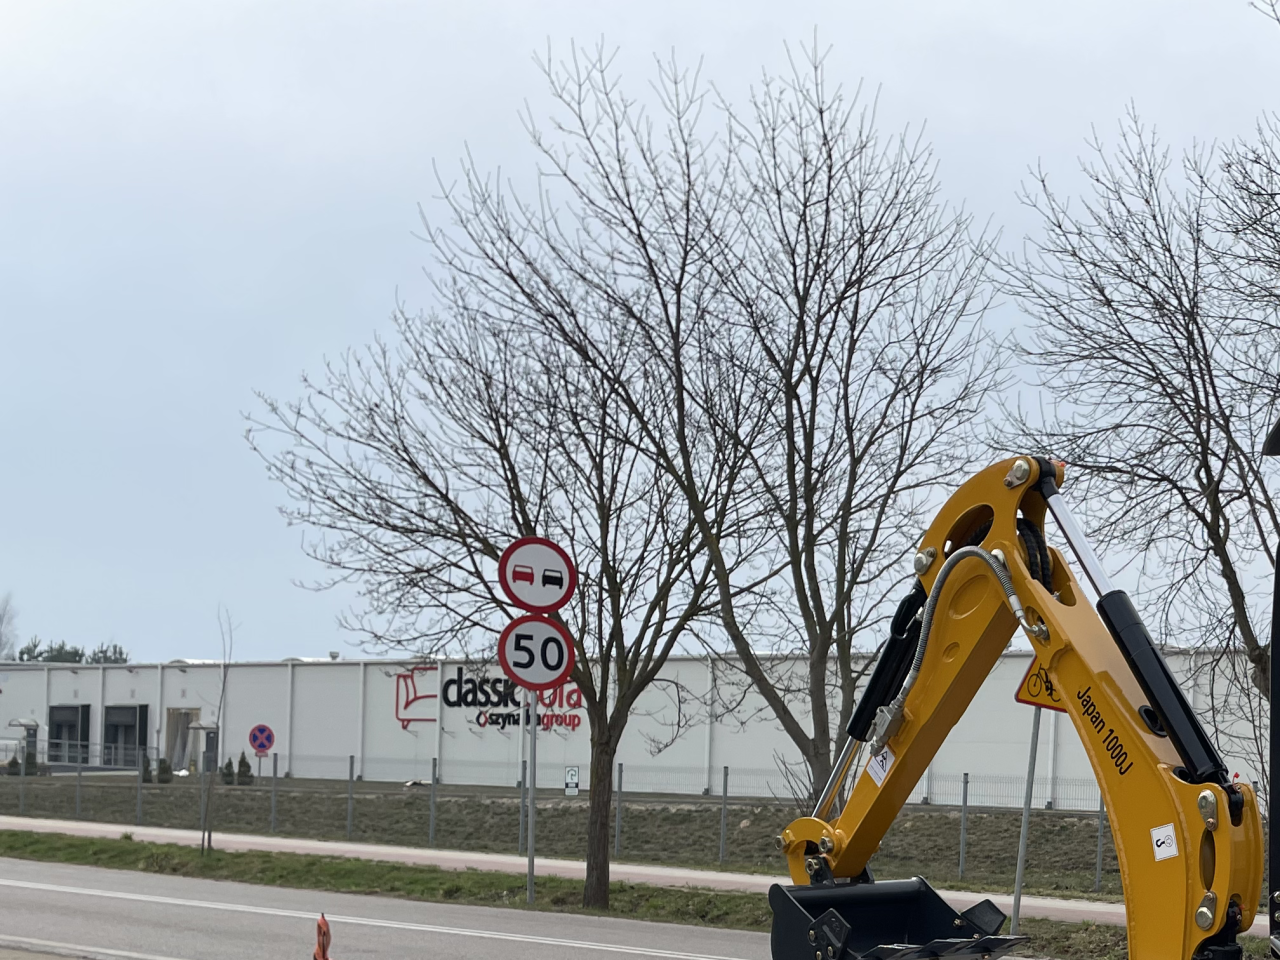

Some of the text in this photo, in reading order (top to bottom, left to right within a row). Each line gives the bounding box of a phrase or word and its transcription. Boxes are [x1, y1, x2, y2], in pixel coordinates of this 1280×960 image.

[512, 633, 564, 671] 50
[1077, 686, 1134, 776] Japan 1000J
